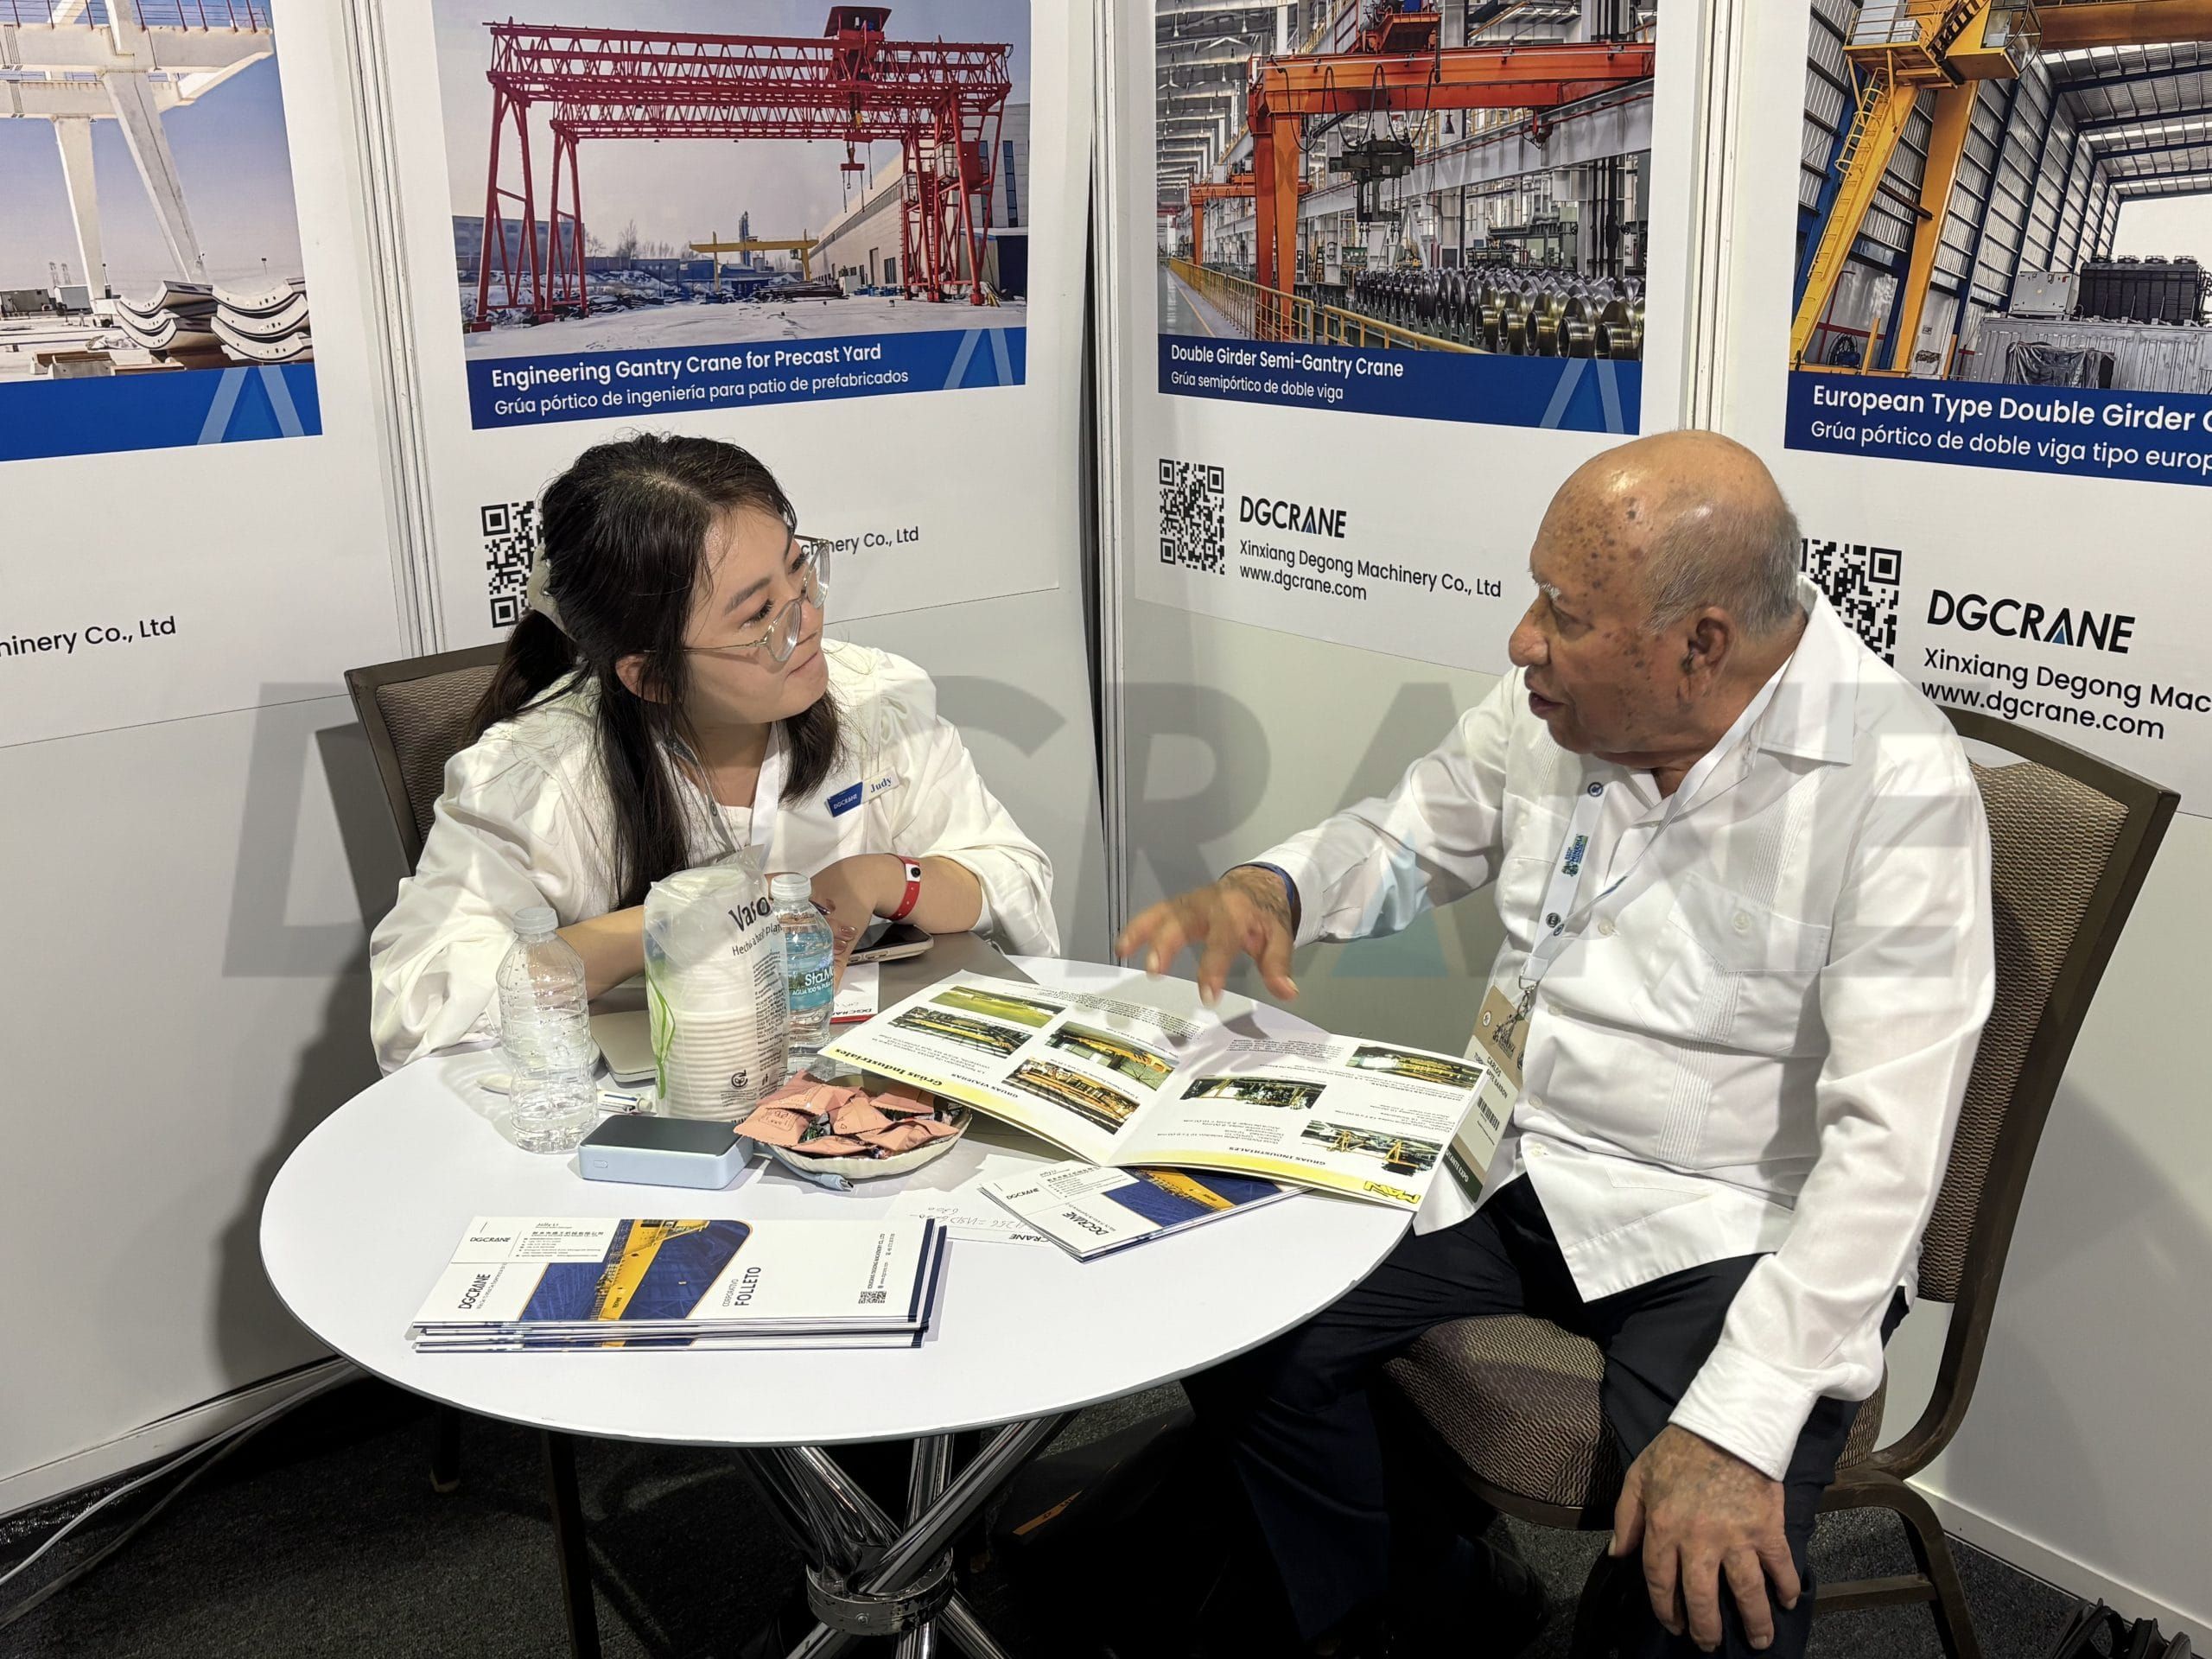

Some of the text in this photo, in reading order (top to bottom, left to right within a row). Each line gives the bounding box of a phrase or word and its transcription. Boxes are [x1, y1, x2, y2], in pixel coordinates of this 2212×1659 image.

[492, 343, 881, 391] Engineering Gantry Crane for Precast Yard
[1171, 344, 1404, 378] Double Girder Semi-Gantry Crane
[494, 370, 909, 416] Grúa pórtico de ingeniería para patio de prefabricados
[1171, 370, 1344, 404] Grúa semipórtico de doble viga
[1813, 385, 1925, 416] European
[1931, 392, 1993, 423] Type
[1999, 397, 2096, 426] Double
[2101, 403, 2196, 432] Girder
[1811, 420, 1856, 442] Grúa
[1860, 424, 1932, 448] pórtico
[1936, 430, 1964, 450] de
[1968, 433, 2031, 456] doble
[2037, 438, 2086, 465] viga
[2092, 442, 2139, 468] tipo
[1239, 495, 1347, 538] DGCRANE
[801, 525, 919, 556] chnery Co., Ltd
[1239, 539, 1502, 598] Xinxiang Degong Machinery Co., Ltd
[1239, 564, 1368, 601] www.dgcrane.com
[85, 626, 133, 645] Co.,
[139, 615, 177, 639] Ltd
[1927, 588, 2136, 654] DGCRANE
[1923, 647, 2212, 714] Xinxiang Degong Mac
[1921, 681, 2165, 741] www.dgcrane.com
[870, 777, 892, 793] Judy
[835, 1048, 906, 1074] Industriales
[907, 1071, 943, 1087] Grúas
[457, 1274, 491, 1309] DGCRANE
[734, 1267, 761, 1306] FOLLETO
